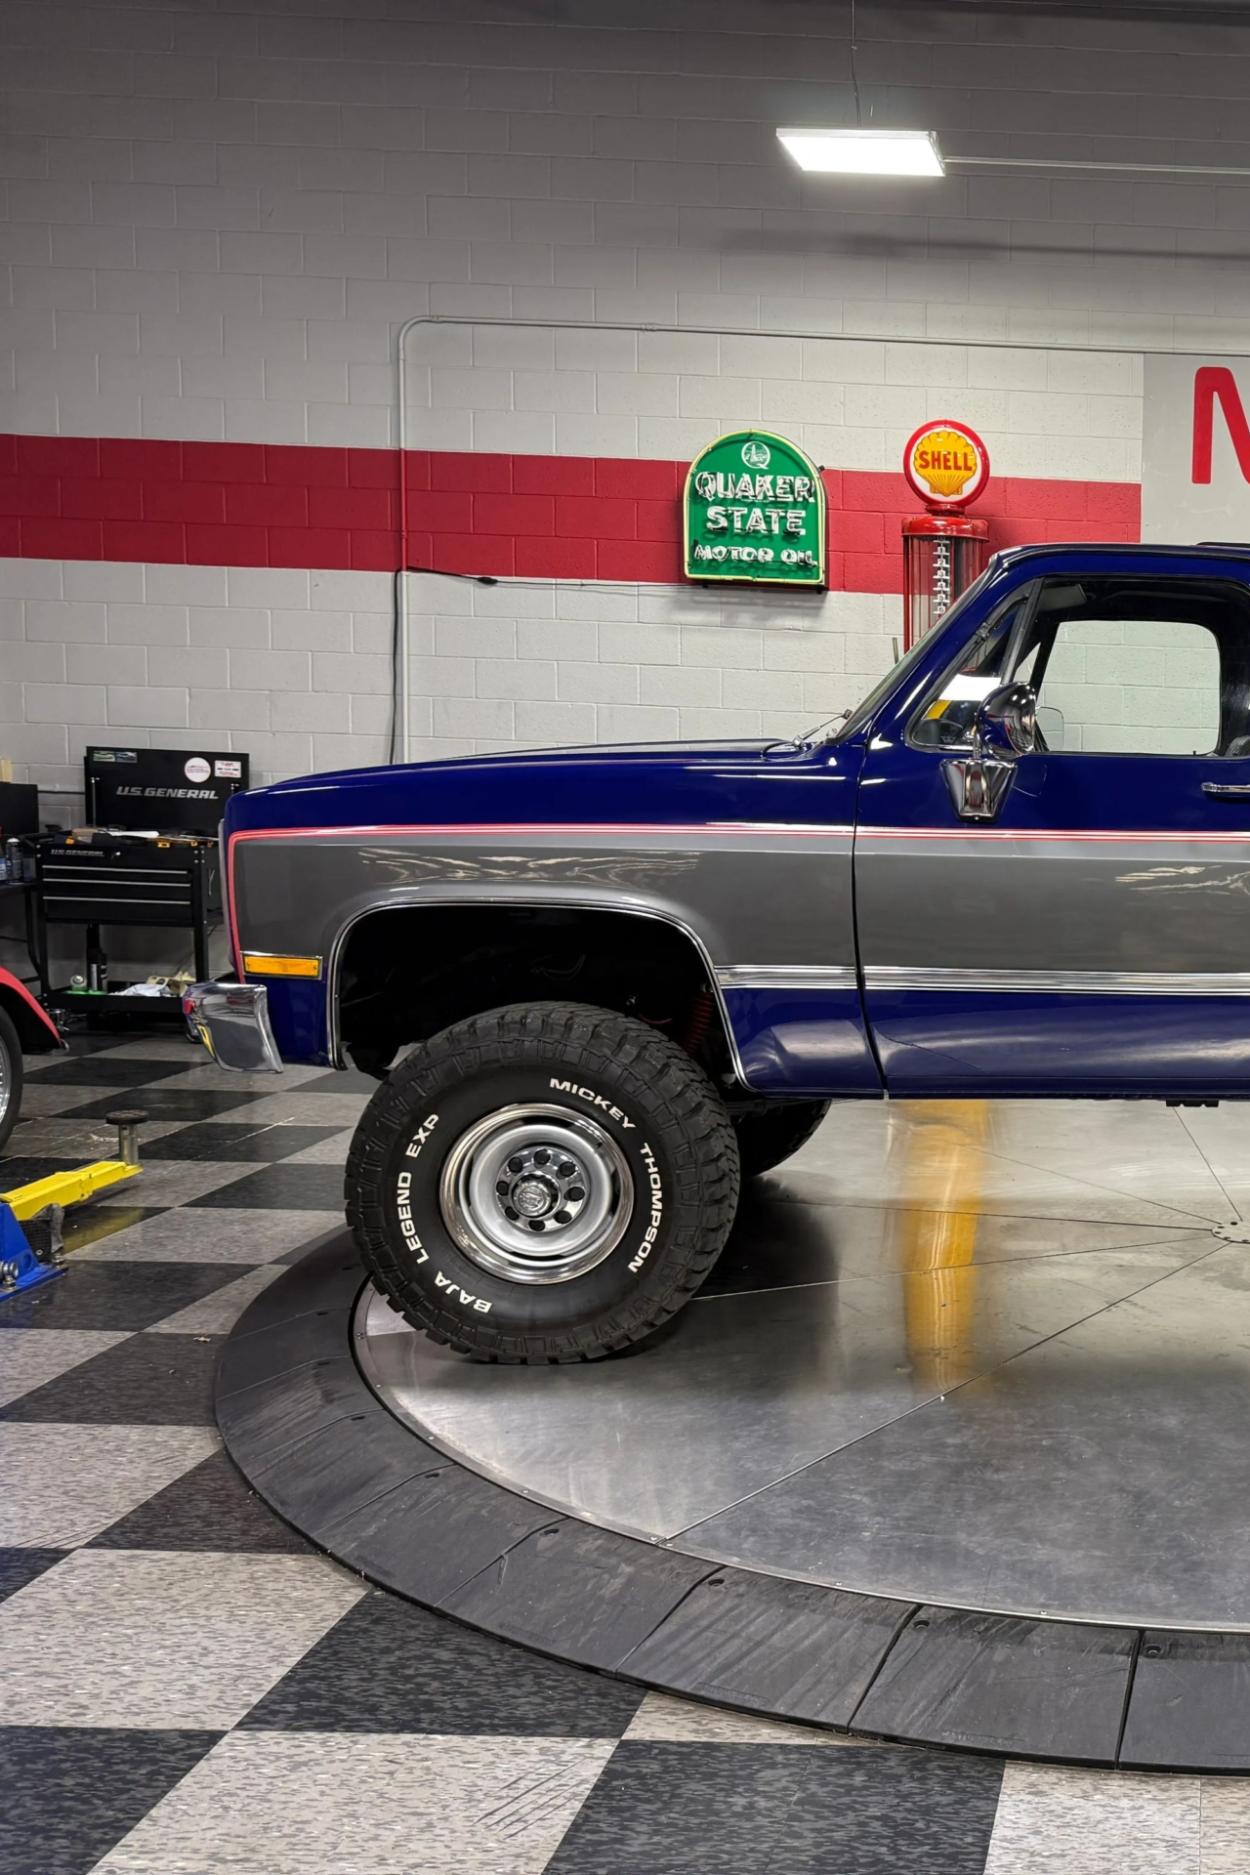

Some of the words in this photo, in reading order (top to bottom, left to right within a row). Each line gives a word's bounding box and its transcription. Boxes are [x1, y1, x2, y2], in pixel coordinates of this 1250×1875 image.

[918, 451, 973, 472] SHELL
[695, 472, 815, 503] QUAKER
[706, 506, 806, 536] STATE
[694, 544, 774, 563] MOTOR
[780, 549, 818, 566] OIL
[144, 787, 219, 800] GENERAL
[405, 1113, 440, 1159] EXP
[549, 1077, 636, 1130] MICKEY
[627, 1142, 663, 1274] THOMPSON
[396, 1171, 430, 1265] LEGEND
[433, 1271, 493, 1314] BAJA
